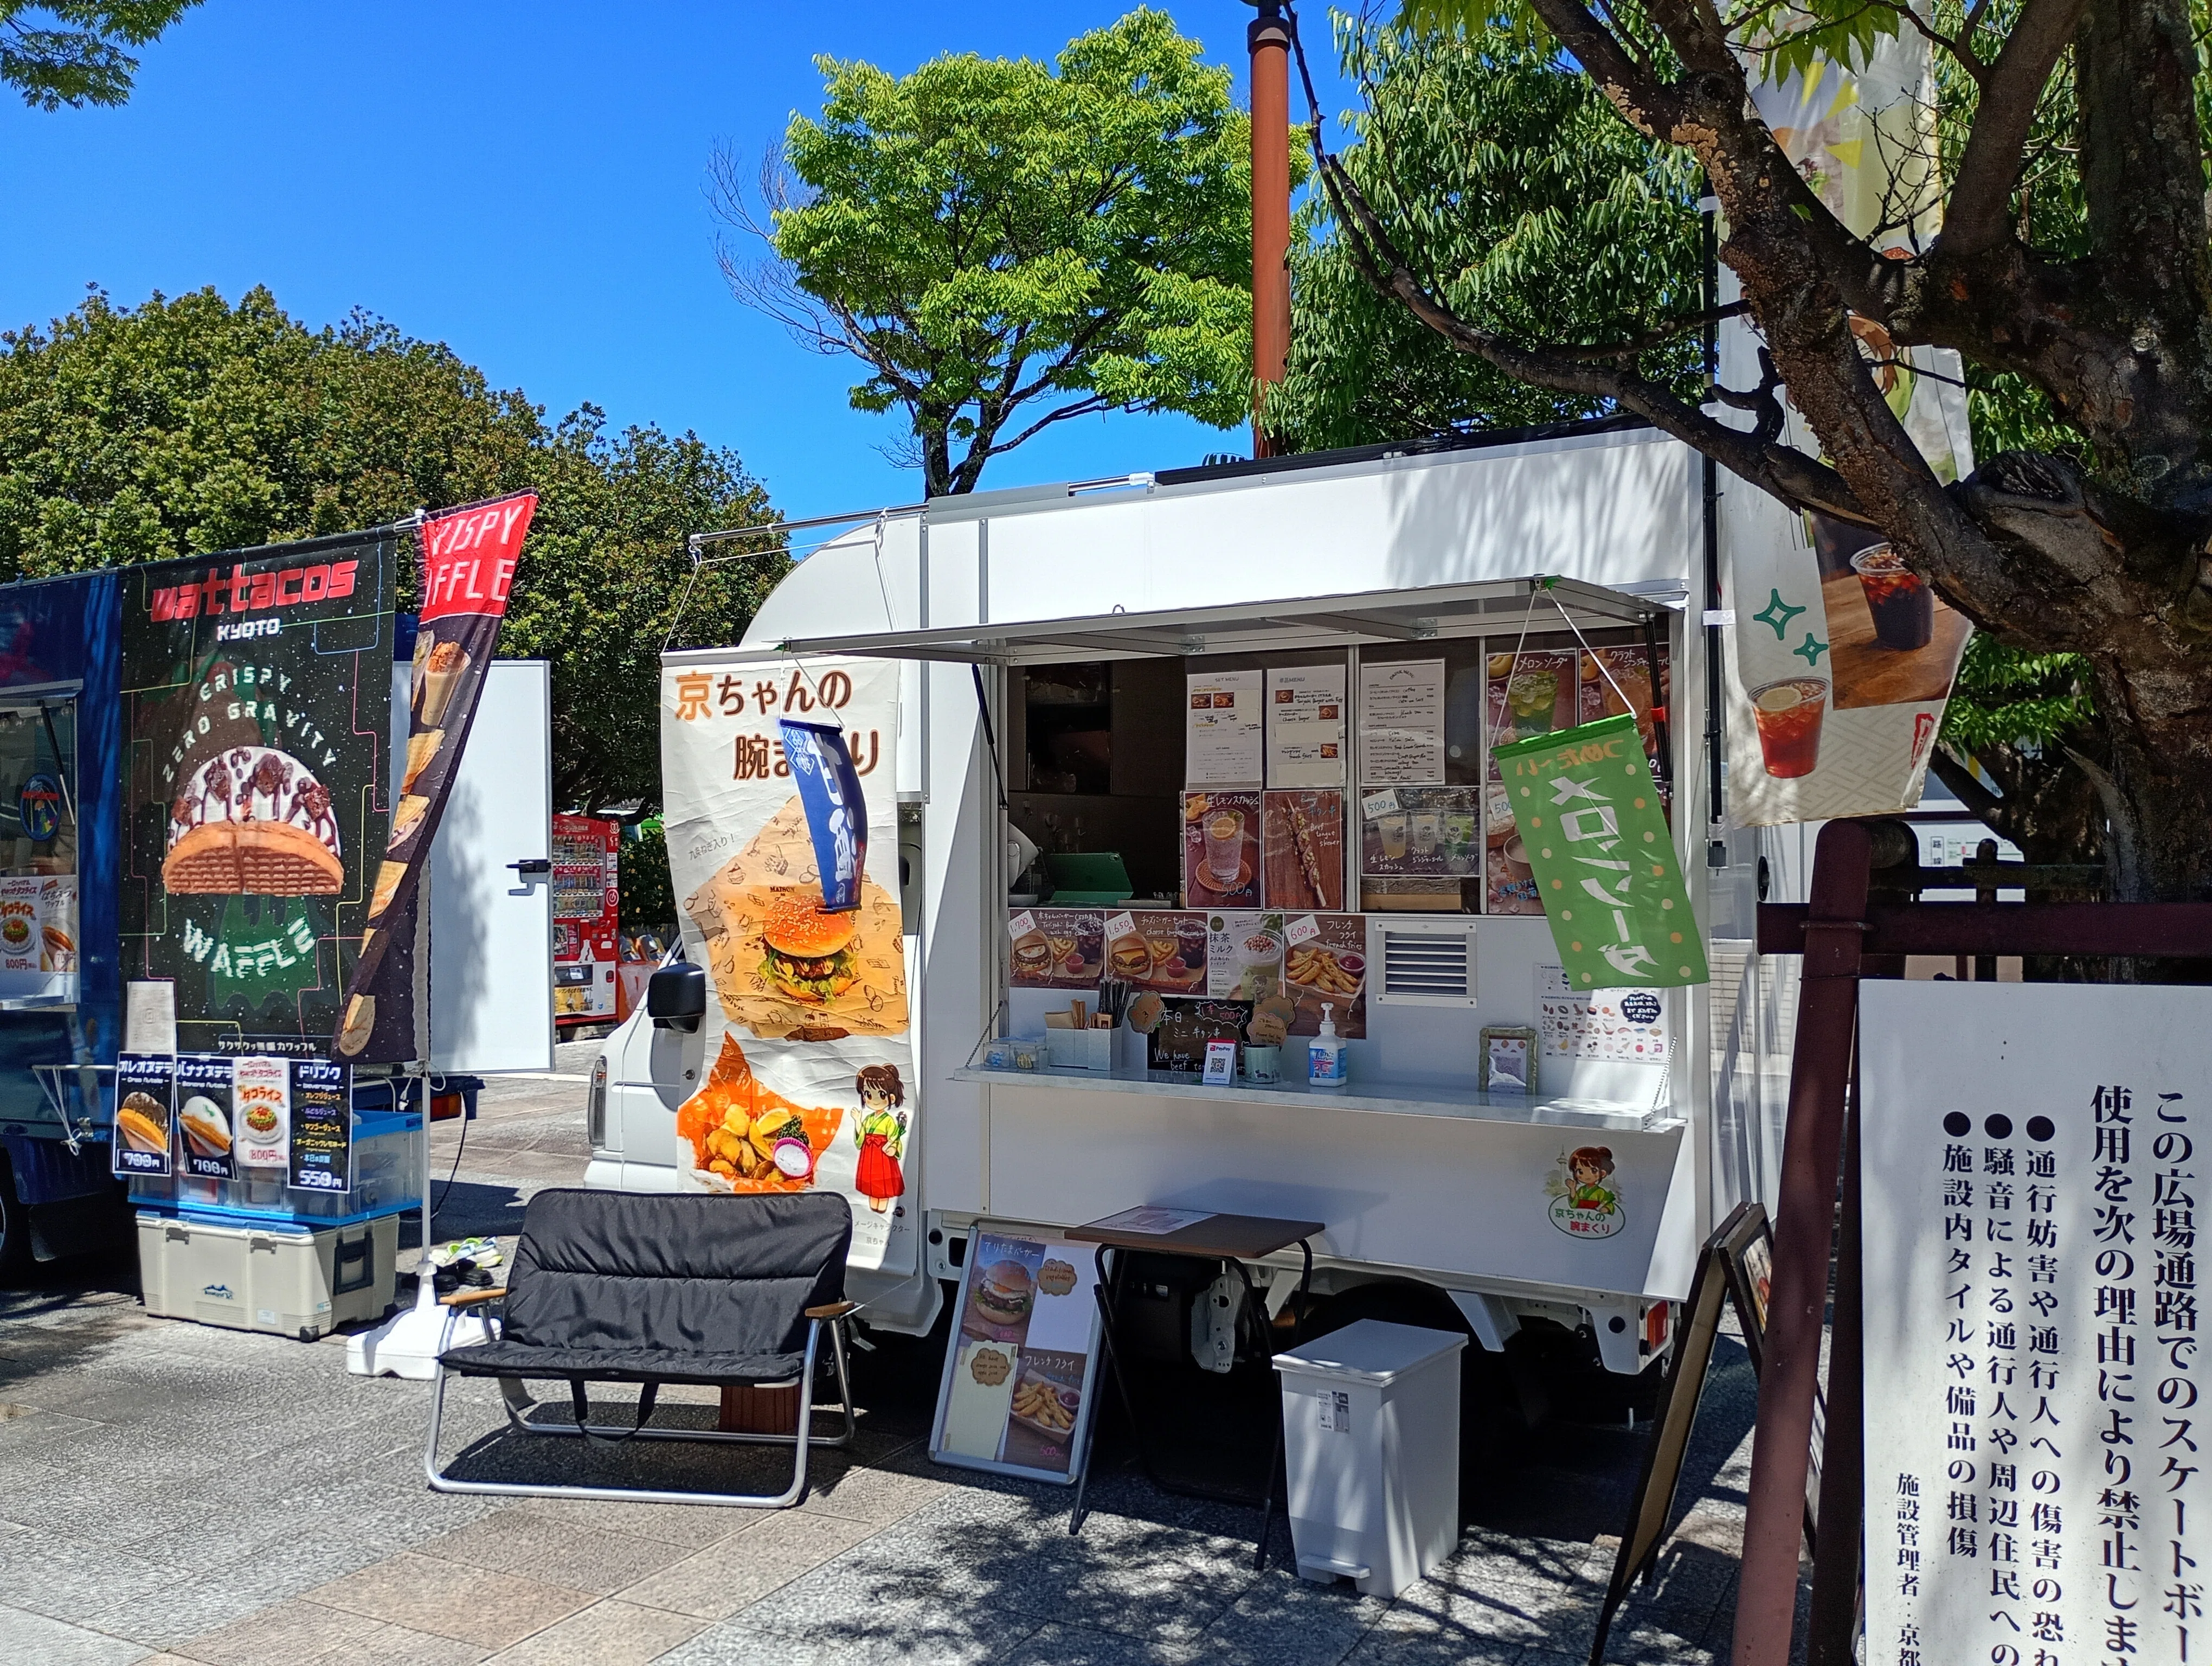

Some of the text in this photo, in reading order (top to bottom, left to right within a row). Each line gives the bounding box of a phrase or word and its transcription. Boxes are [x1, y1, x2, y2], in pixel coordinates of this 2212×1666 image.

[432, 505, 525, 558] RISPY
[150, 560, 359, 622] wattacos
[425, 559, 516, 607] FFLE
[217, 618, 281, 641] KYOTO
[1610, 649, 1636, 662] クラフト
[1517, 657, 1568, 672] メロンソーダ
[200, 667, 292, 702] CRISPY
[674, 669, 853, 721] 京ちゃんの
[163, 701, 337, 783] ZERO GRAVITY
[732, 728, 880, 780] 腕まり
[1206, 795, 1259, 808] 生レモンスカッシュ
[1367, 800, 1396, 813] 500円
[1450, 853, 1478, 861] メロンソーダ
[1220, 881, 1252, 898] 500円
[1009, 917, 1033, 933] 1,700円
[1108, 920, 1134, 935] 1,650円
[1290, 925, 1316, 940] 600円
[1327, 920, 1353, 930] フレンチ
[1209, 932, 1230, 943] 抹茶
[1339, 931, 1356, 940] フライ
[183, 917, 316, 978] WAFFLE
[1210, 945, 1233, 953] ミルク
[1325, 939, 1362, 950] french fries
[1160, 1007, 1182, 1026] 本日
[1154, 1047, 1191, 1062] We have
[174, 1060, 233, 1079] バナナヌテラ
[299, 1065, 342, 1080] ドリンク
[1170, 1060, 1188, 1071] beef
[242, 1086, 284, 1104] タコライス
[123, 1152, 160, 1168] 700円
[249, 1149, 277, 1161] 800円
[193, 1158, 228, 1176] 700円
[1554, 1208, 1606, 1222] 京ちゃんの
[854, 1220, 910, 1232] メージキャラクター
[1570, 1220, 1610, 1234] 腕まくり
[985, 1241, 1040, 1258] てりたまバーガー
[1942, 1143, 1978, 1559] 施設内タイルや備品の損傷
[1025, 1355, 1075, 1372] フレンチ フライ
[2151, 1092, 2204, 1663] この広場通路でのスケートボー
[1983, 1146, 2020, 1666] 騒音による通行人や周辺住民への
